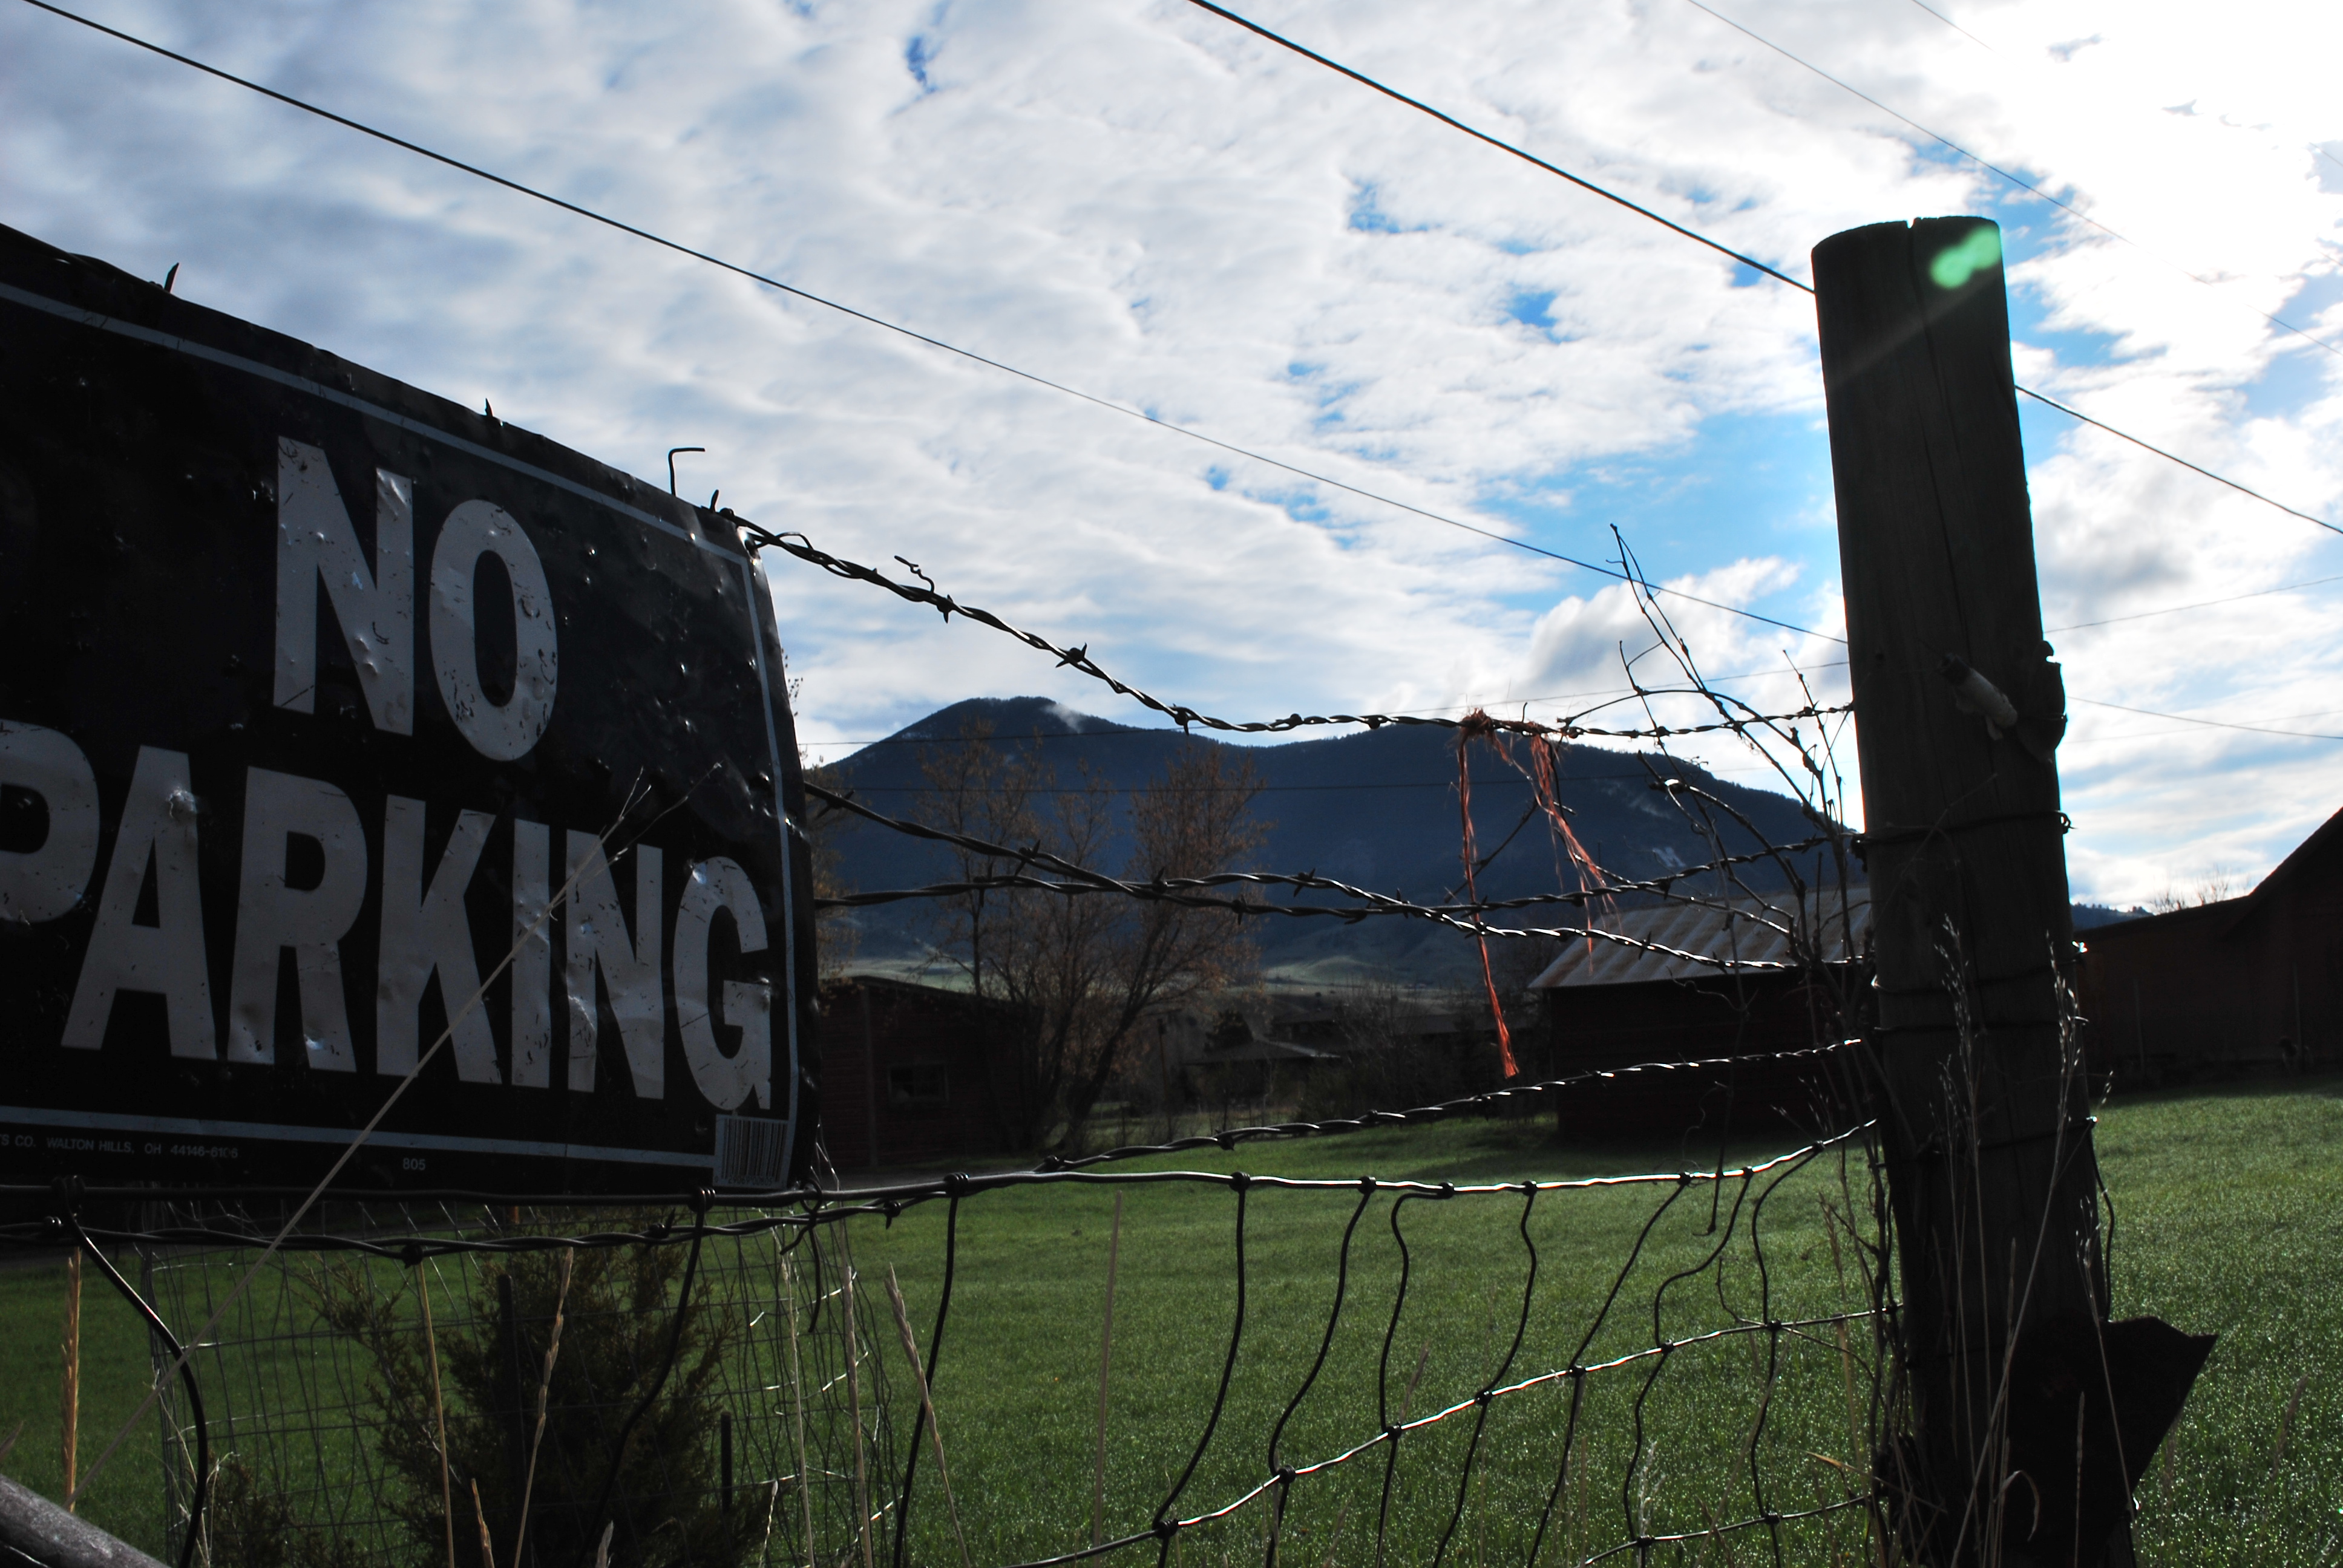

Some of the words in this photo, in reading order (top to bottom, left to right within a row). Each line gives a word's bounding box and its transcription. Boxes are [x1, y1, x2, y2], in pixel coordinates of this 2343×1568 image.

[273, 436, 558, 763] NO
[0, 719, 772, 1111] PARKING
[15, 1134, 36, 1148] CO.
[46, 1137, 95, 1151] WALTON
[99, 1140, 136, 1154] HILLS,
[144, 1142, 162, 1155] OH
[403, 1157, 426, 1171] 805
